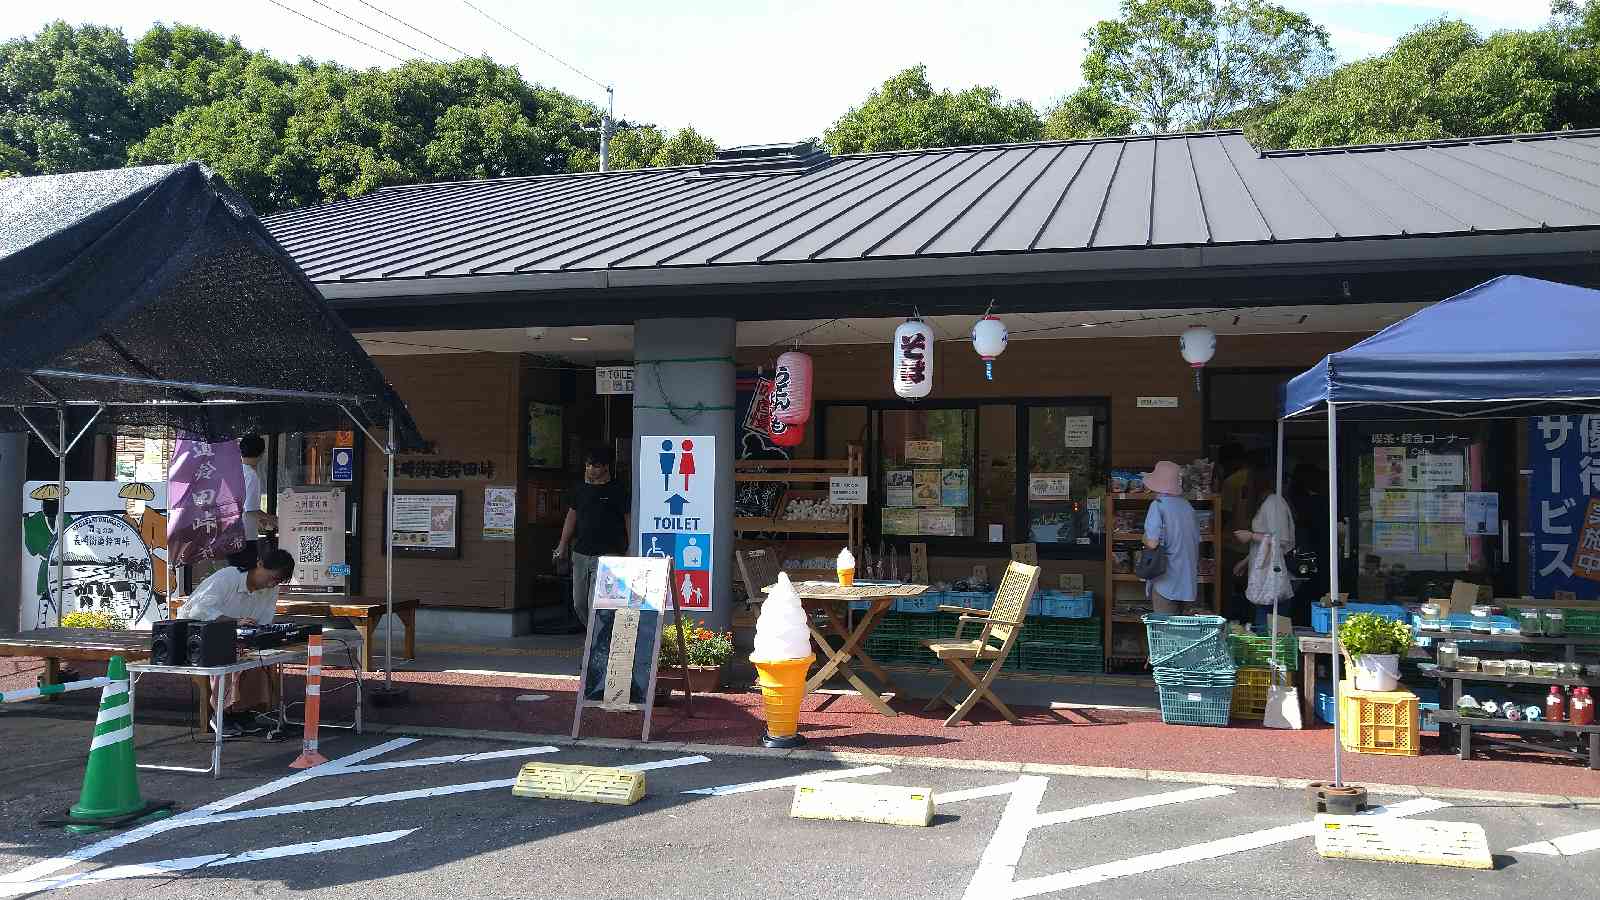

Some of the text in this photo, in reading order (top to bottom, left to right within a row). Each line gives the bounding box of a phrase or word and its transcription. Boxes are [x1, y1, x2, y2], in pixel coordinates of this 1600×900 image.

[608, 370, 633, 380] TOILE
[1537, 416, 1577, 578] サービス
[653, 516, 701, 531] TOILET
